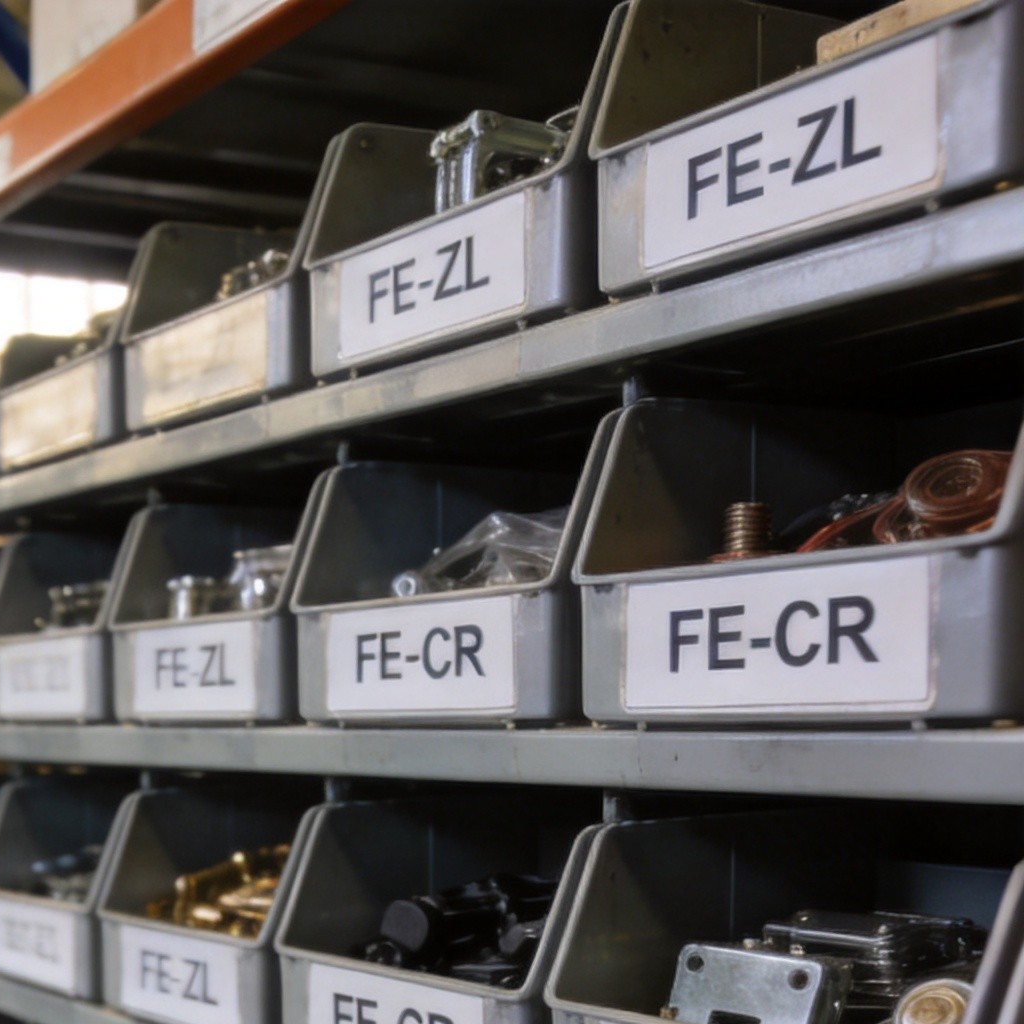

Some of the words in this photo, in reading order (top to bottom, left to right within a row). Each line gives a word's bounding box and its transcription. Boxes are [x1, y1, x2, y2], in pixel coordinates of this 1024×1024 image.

[687, 97, 881, 220] FE-ZL
[369, 236, 489, 323] FE-ZL
[154, 642, 236, 690] FE-ZL
[356, 624, 484, 683] FE-CR
[669, 595, 880, 673] FE-CR
[140, 949, 219, 1006] FE-ZL
